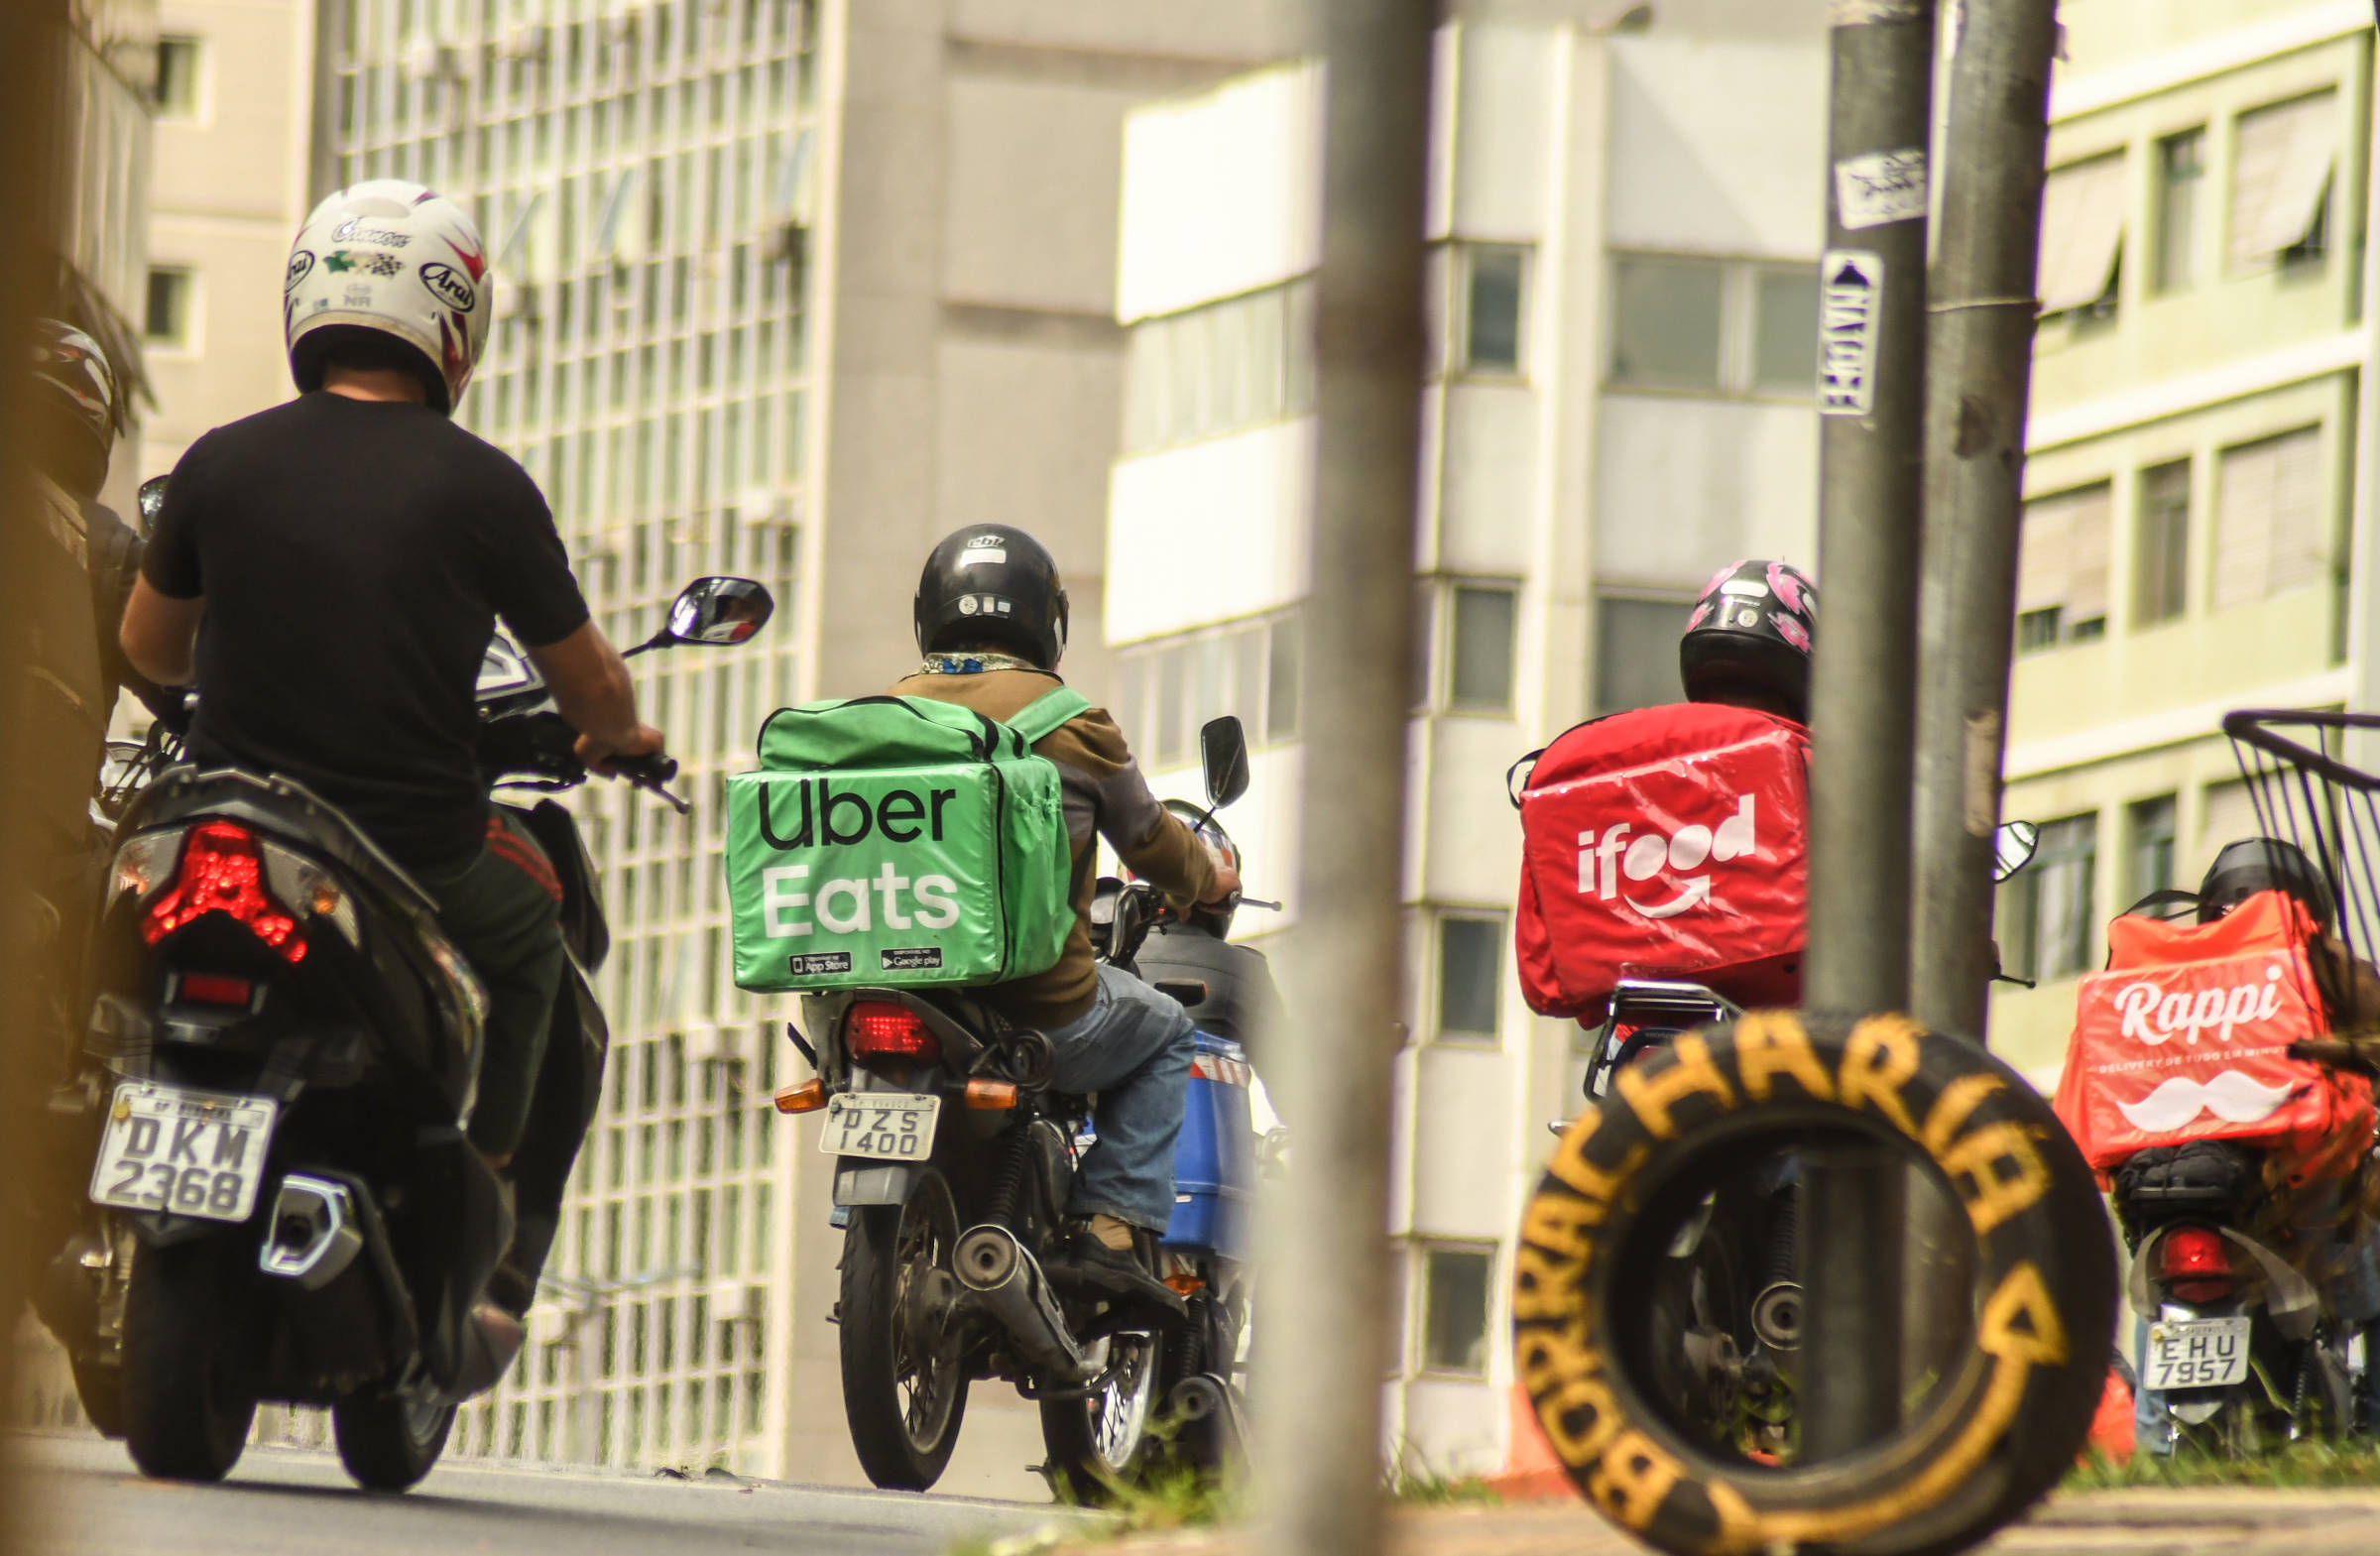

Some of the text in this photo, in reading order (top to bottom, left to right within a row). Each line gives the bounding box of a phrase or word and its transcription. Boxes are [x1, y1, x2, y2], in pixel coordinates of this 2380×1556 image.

[422, 270, 471, 305] Arai
[759, 778, 956, 850] Uber
[763, 862, 960, 938] Eats
[805, 960, 849, 973] App Store
[893, 956, 940, 967] Google play
[2114, 965, 2283, 1045] Rappi
[2098, 1058, 2163, 1074] DELIVERY
[2165, 1056, 2182, 1066] DE
[2186, 1053, 2220, 1064] TUDO
[843, 1110, 918, 1133] DZS
[124, 1116, 249, 1170] DKM
[840, 1131, 917, 1154] 1400
[105, 1159, 243, 1215] 2368
[1513, 1009, 2051, 1529] BORRACHARIA
[2162, 1335, 2235, 1360] EHU
[2157, 1358, 2237, 1385] 7957
